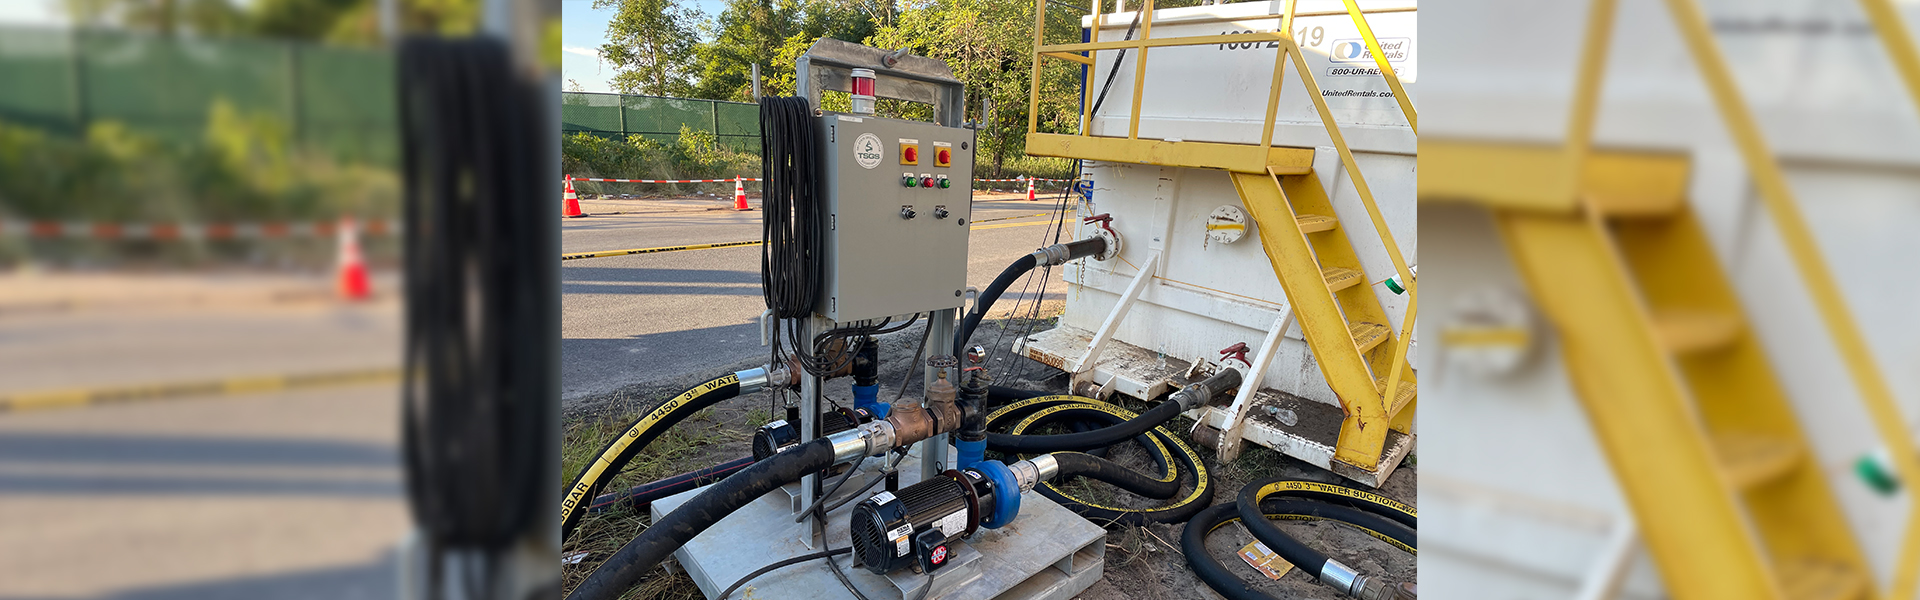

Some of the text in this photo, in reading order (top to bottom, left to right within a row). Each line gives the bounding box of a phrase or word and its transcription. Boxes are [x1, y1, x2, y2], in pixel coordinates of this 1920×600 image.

[1364, 41, 1403, 50] Uited
[1362, 50, 1404, 59] Retals
[857, 152, 880, 160] TSGS
[651, 400, 679, 422] 4450
[1285, 482, 1302, 490] 4450
[1318, 484, 1350, 496] WATER
[1353, 490, 1397, 508] SUCTION
